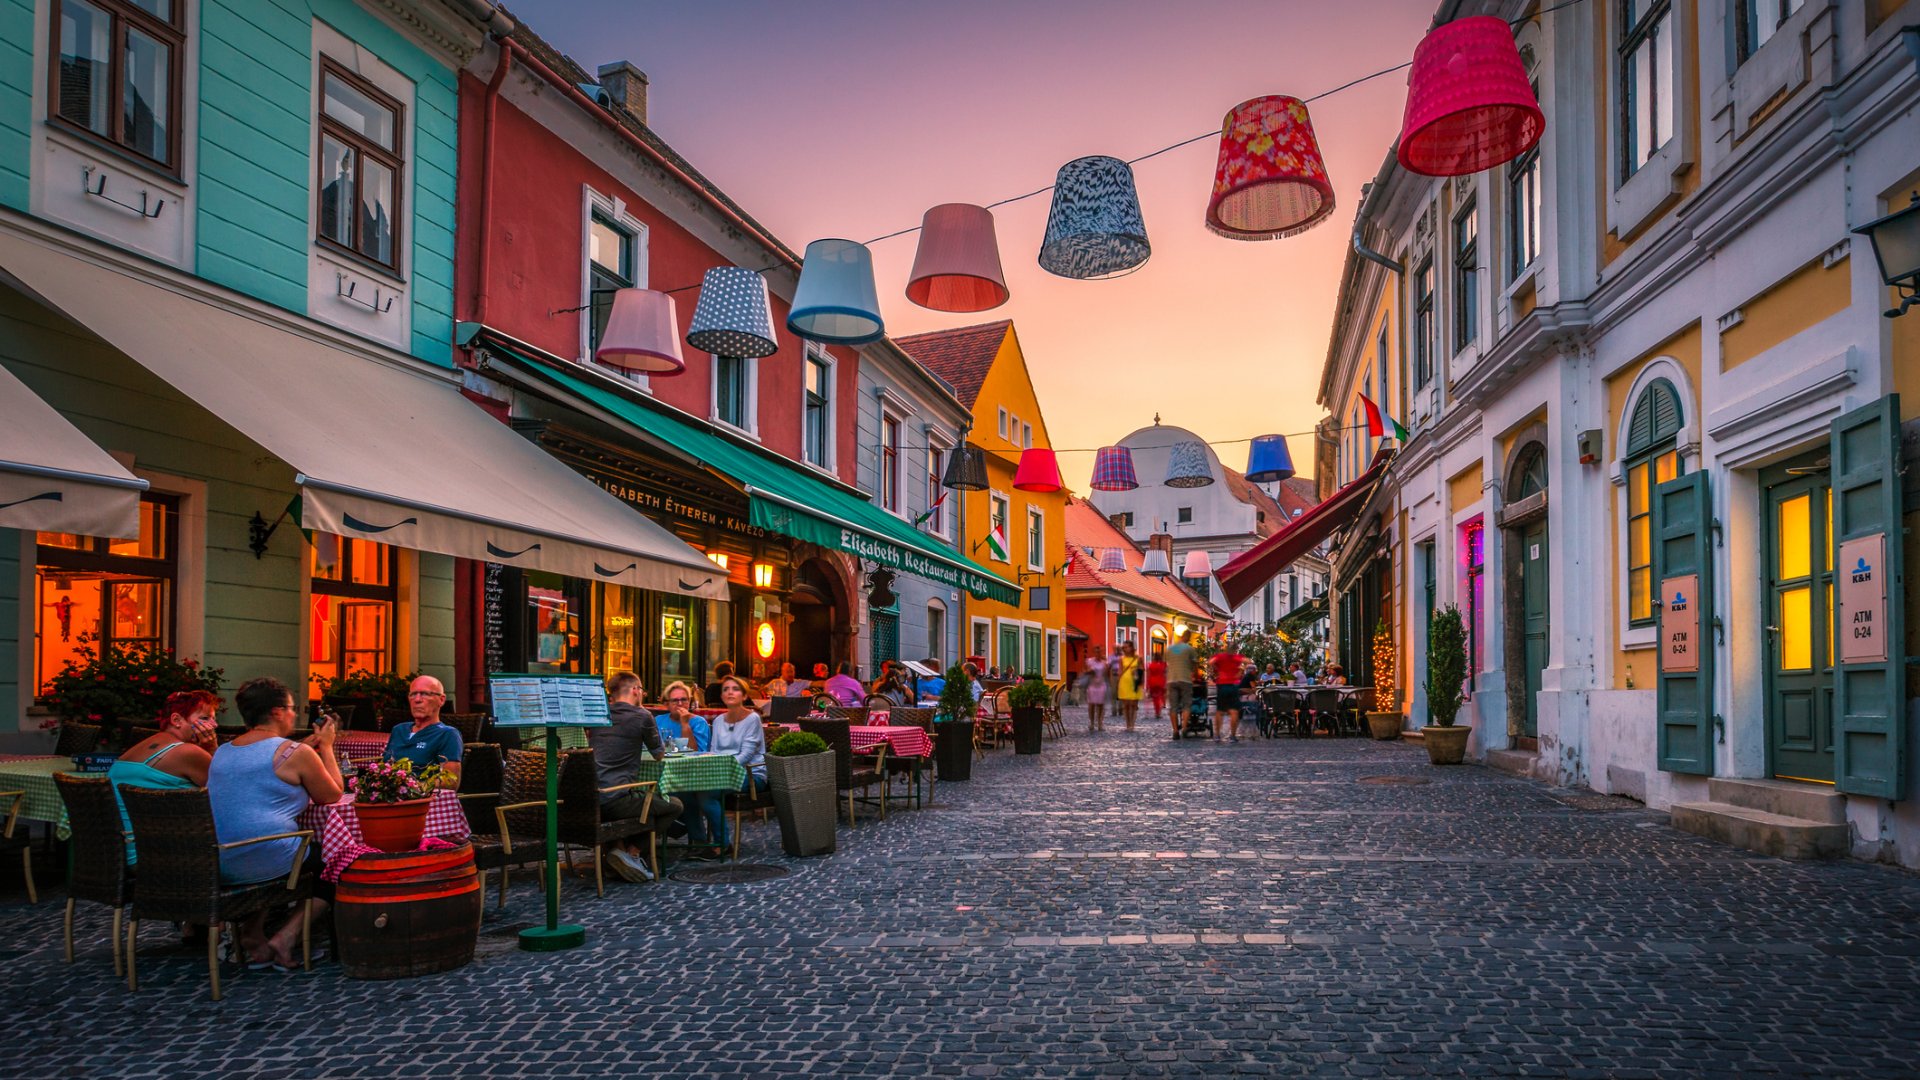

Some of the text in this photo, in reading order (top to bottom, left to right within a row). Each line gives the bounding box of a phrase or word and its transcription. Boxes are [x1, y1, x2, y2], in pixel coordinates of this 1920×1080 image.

[665, 496, 716, 525] ÉTTEREM
[840, 528, 900, 567] Elisabeth
[904, 550, 958, 583] Restaurant
[960, 571, 967, 588] &
[970, 574, 988, 594] Cafe
[1852, 572, 1871, 583] K&H
[1671, 603, 1687, 612] K&H
[1853, 610, 1872, 623] ATM
[1672, 632, 1687, 642] ATM
[1854, 626, 1872, 639] 0-24
[1672, 644, 1687, 654] 0-24
